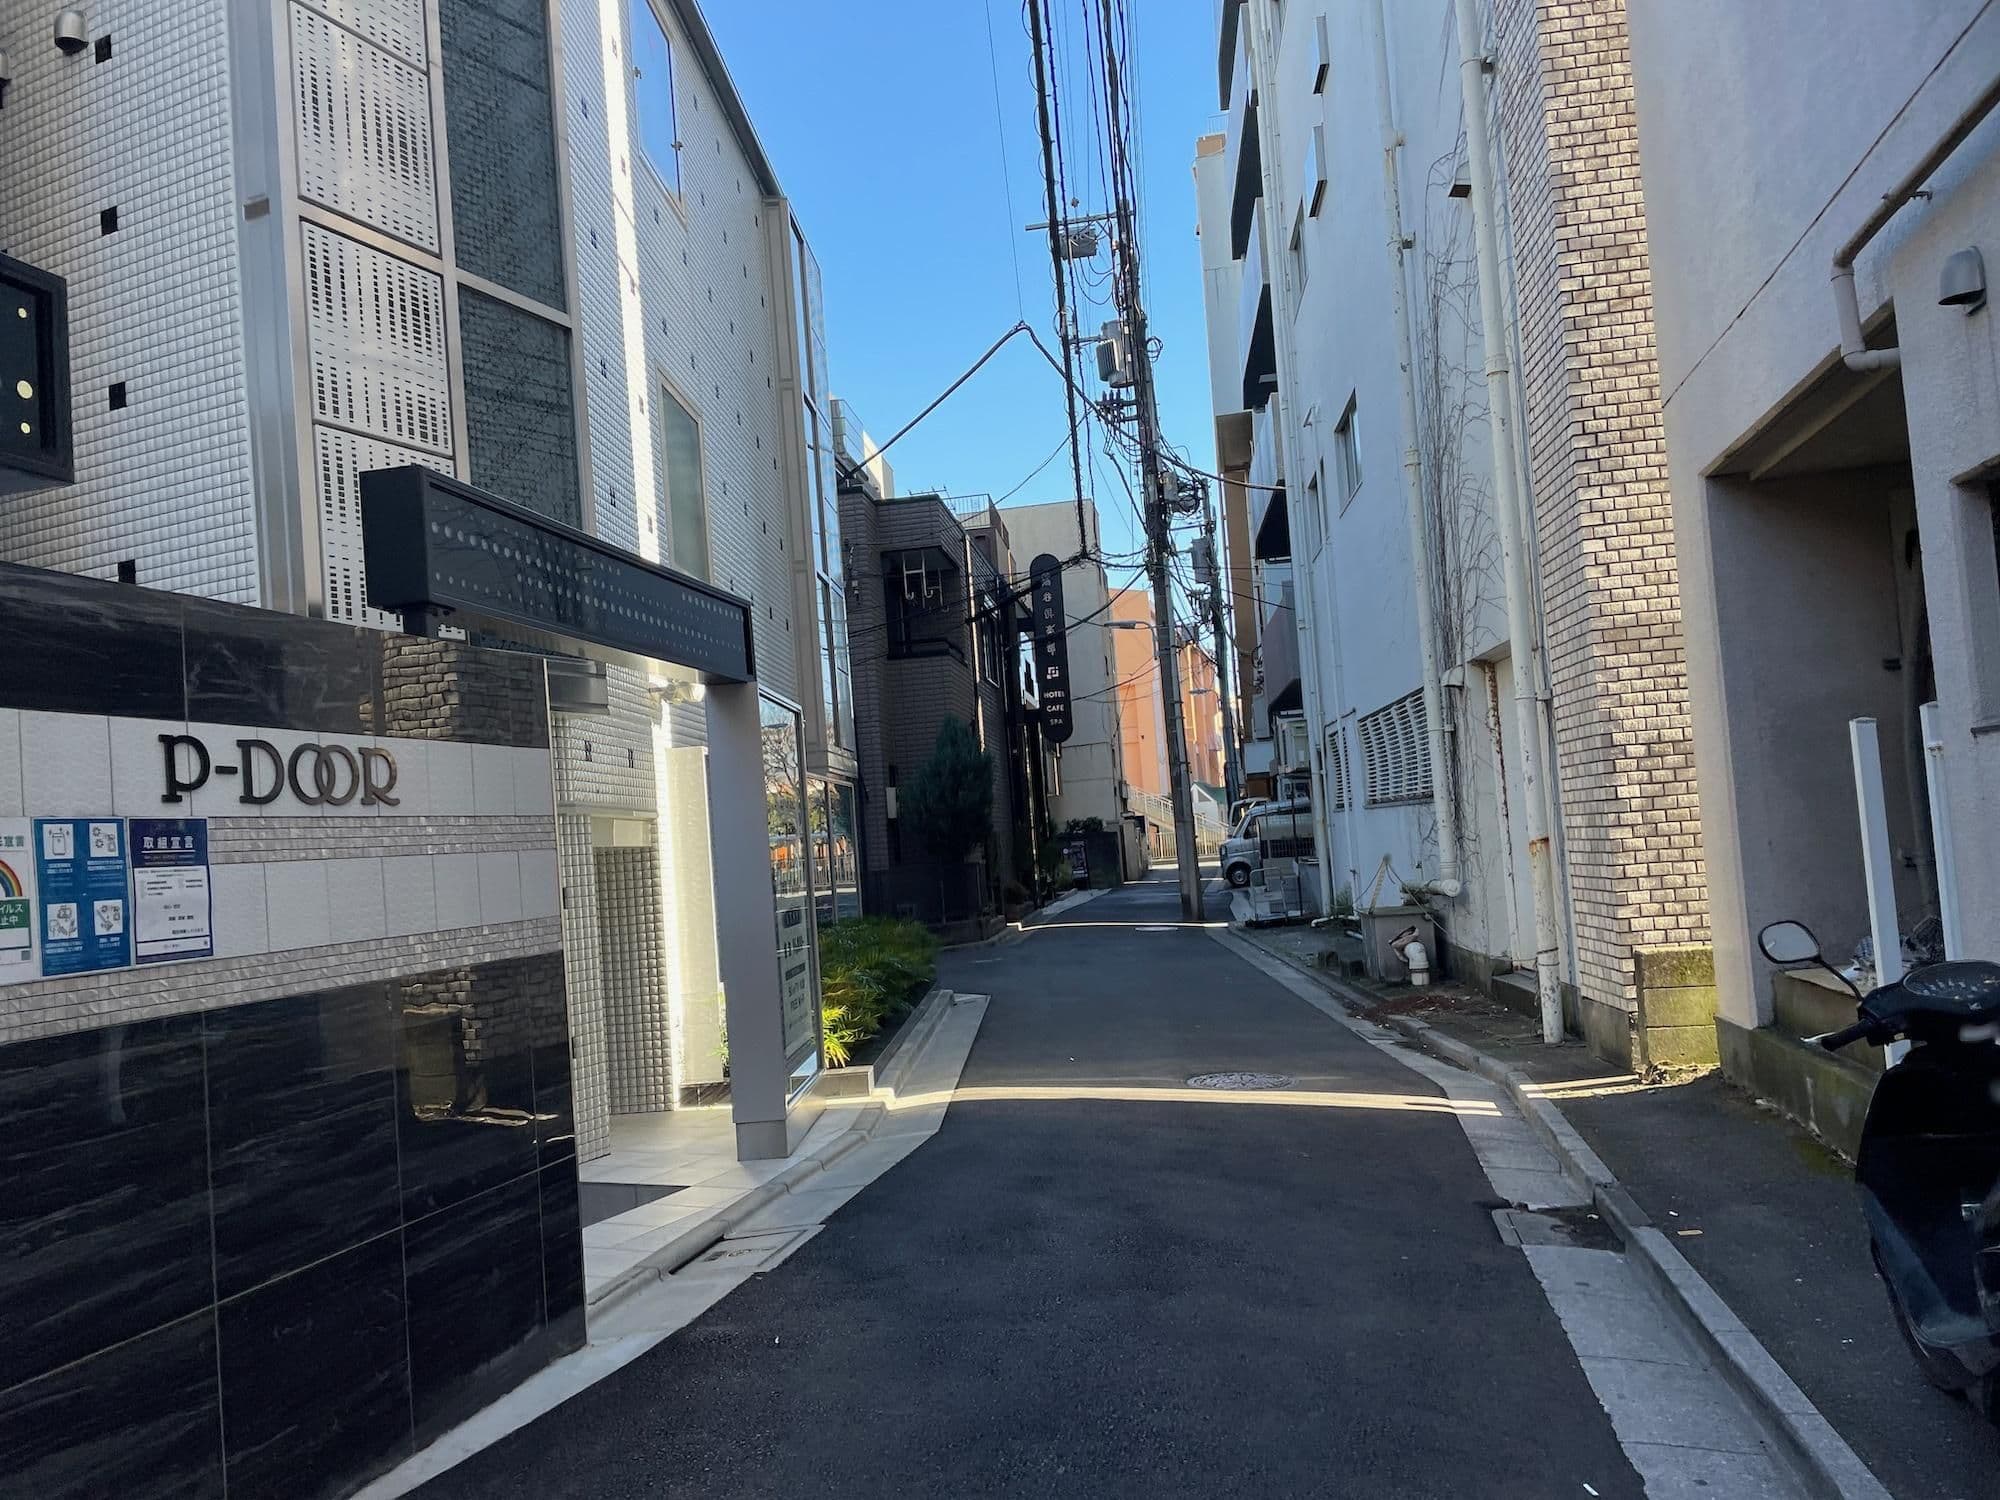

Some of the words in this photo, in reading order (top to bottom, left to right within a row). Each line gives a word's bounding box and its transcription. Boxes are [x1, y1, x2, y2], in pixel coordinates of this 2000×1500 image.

[1043, 690, 1065, 699] HOTEL
[1046, 704, 1065, 713] CAFE
[1049, 717, 1064, 727] SPA
[158, 734, 400, 806] P-DOOR
[0, 835, 25, 848] 宣言
[142, 835, 194, 849] 取組宣言
